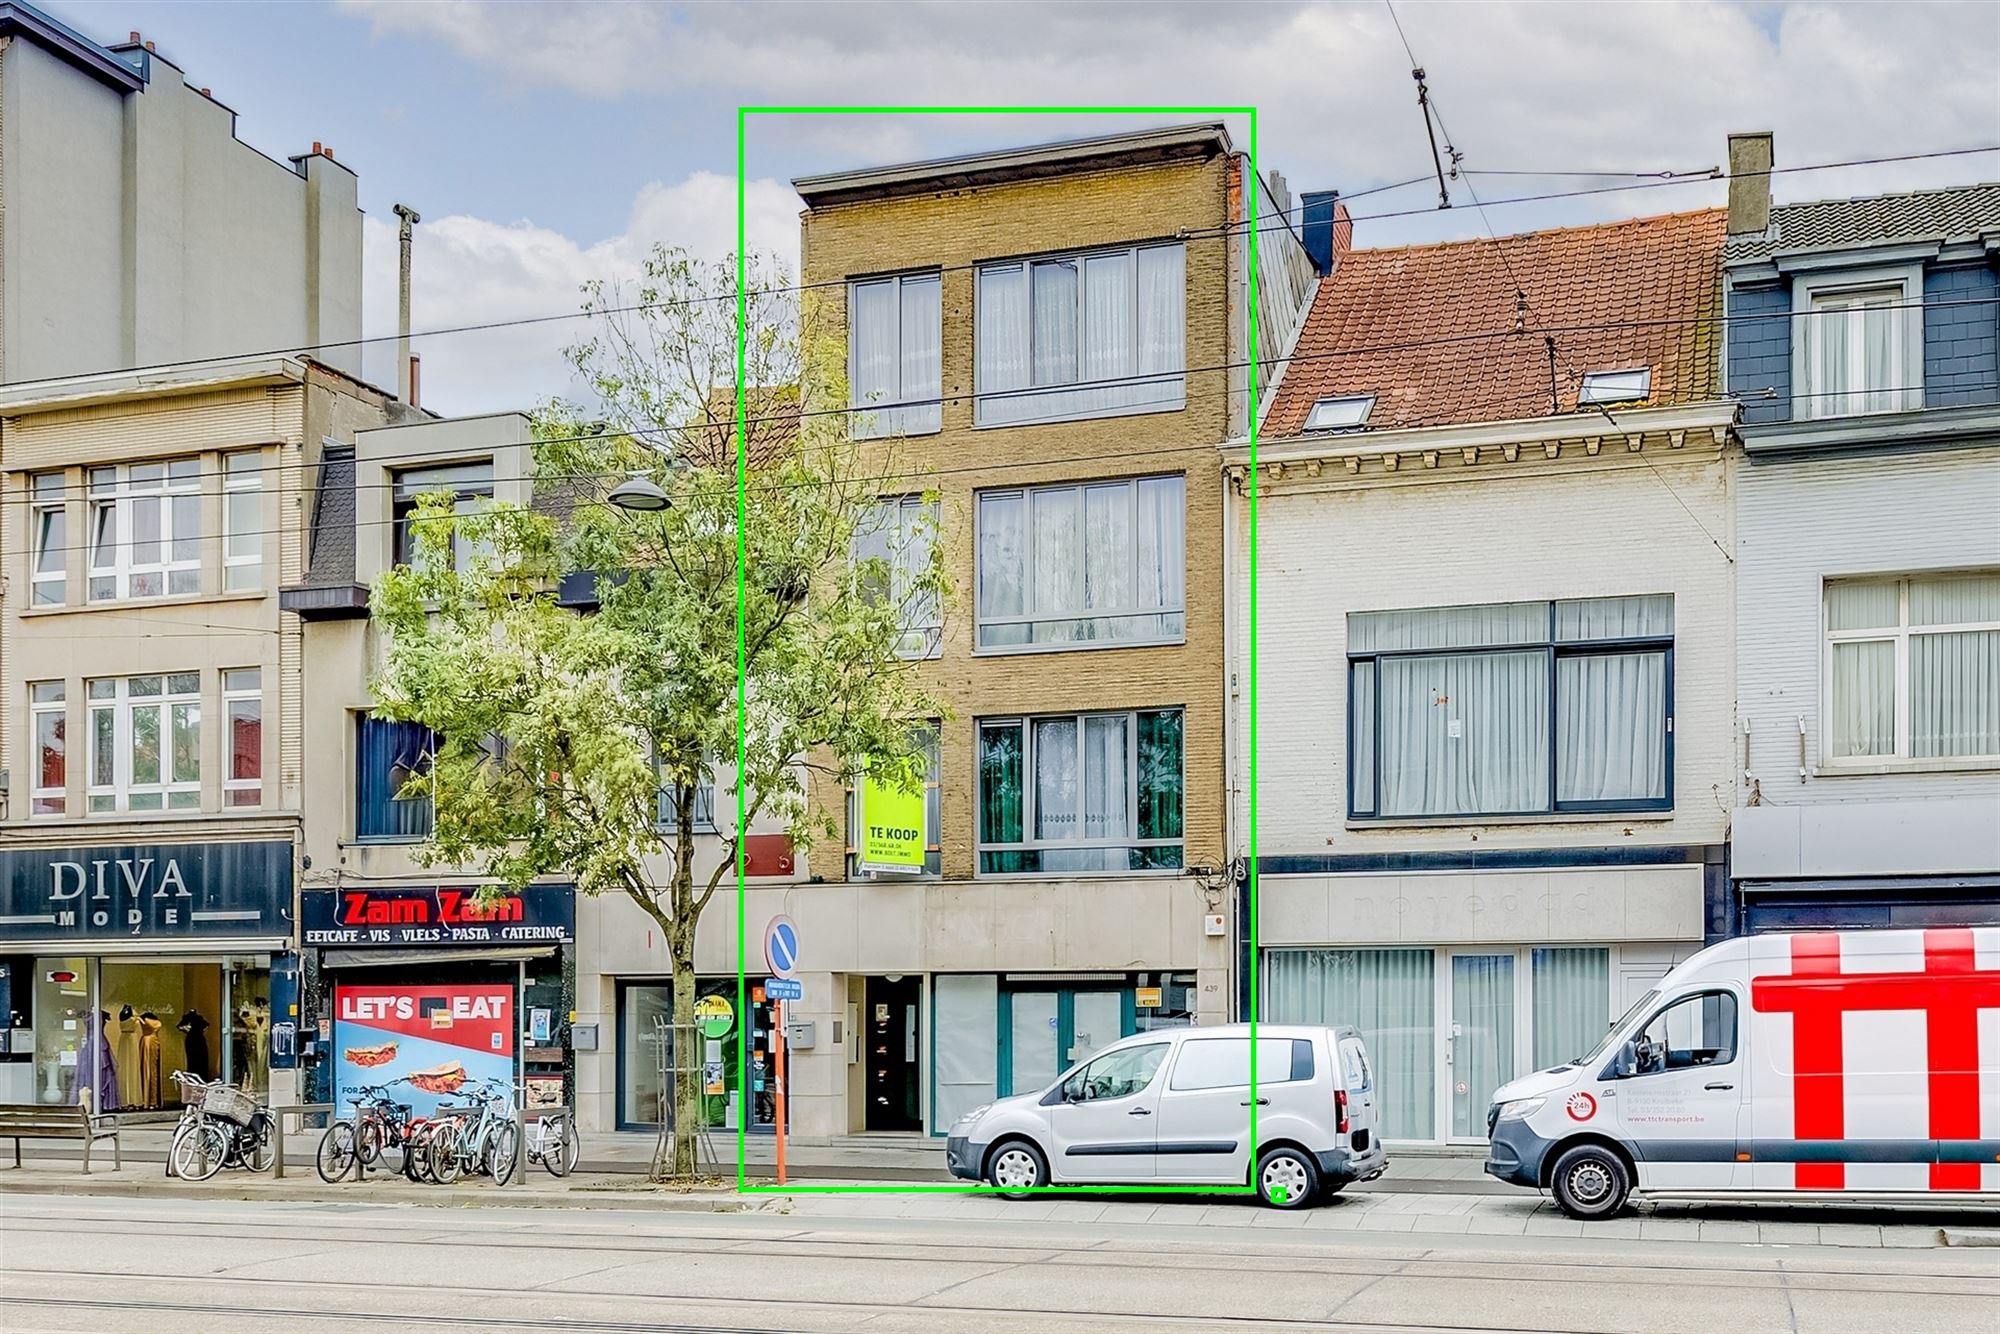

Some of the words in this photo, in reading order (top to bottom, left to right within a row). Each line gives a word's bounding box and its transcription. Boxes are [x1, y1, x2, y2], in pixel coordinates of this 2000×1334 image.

[870, 826, 883, 838] TE
[887, 828, 918, 841] KOOP
[49, 859, 192, 900] DIVA
[344, 893, 428, 924] Zam
[437, 892, 523, 922] Zam
[59, 909, 177, 927] MODE
[306, 930, 358, 943] EETCAFE
[369, 929, 391, 942] VIS
[452, 928, 490, 940] PASTA
[502, 926, 565, 939] CATERING
[1204, 985, 1218, 993] 439
[342, 997, 413, 1020] LET'S
[452, 996, 506, 1019] EAT
[342, 1086, 358, 1094] FOR
